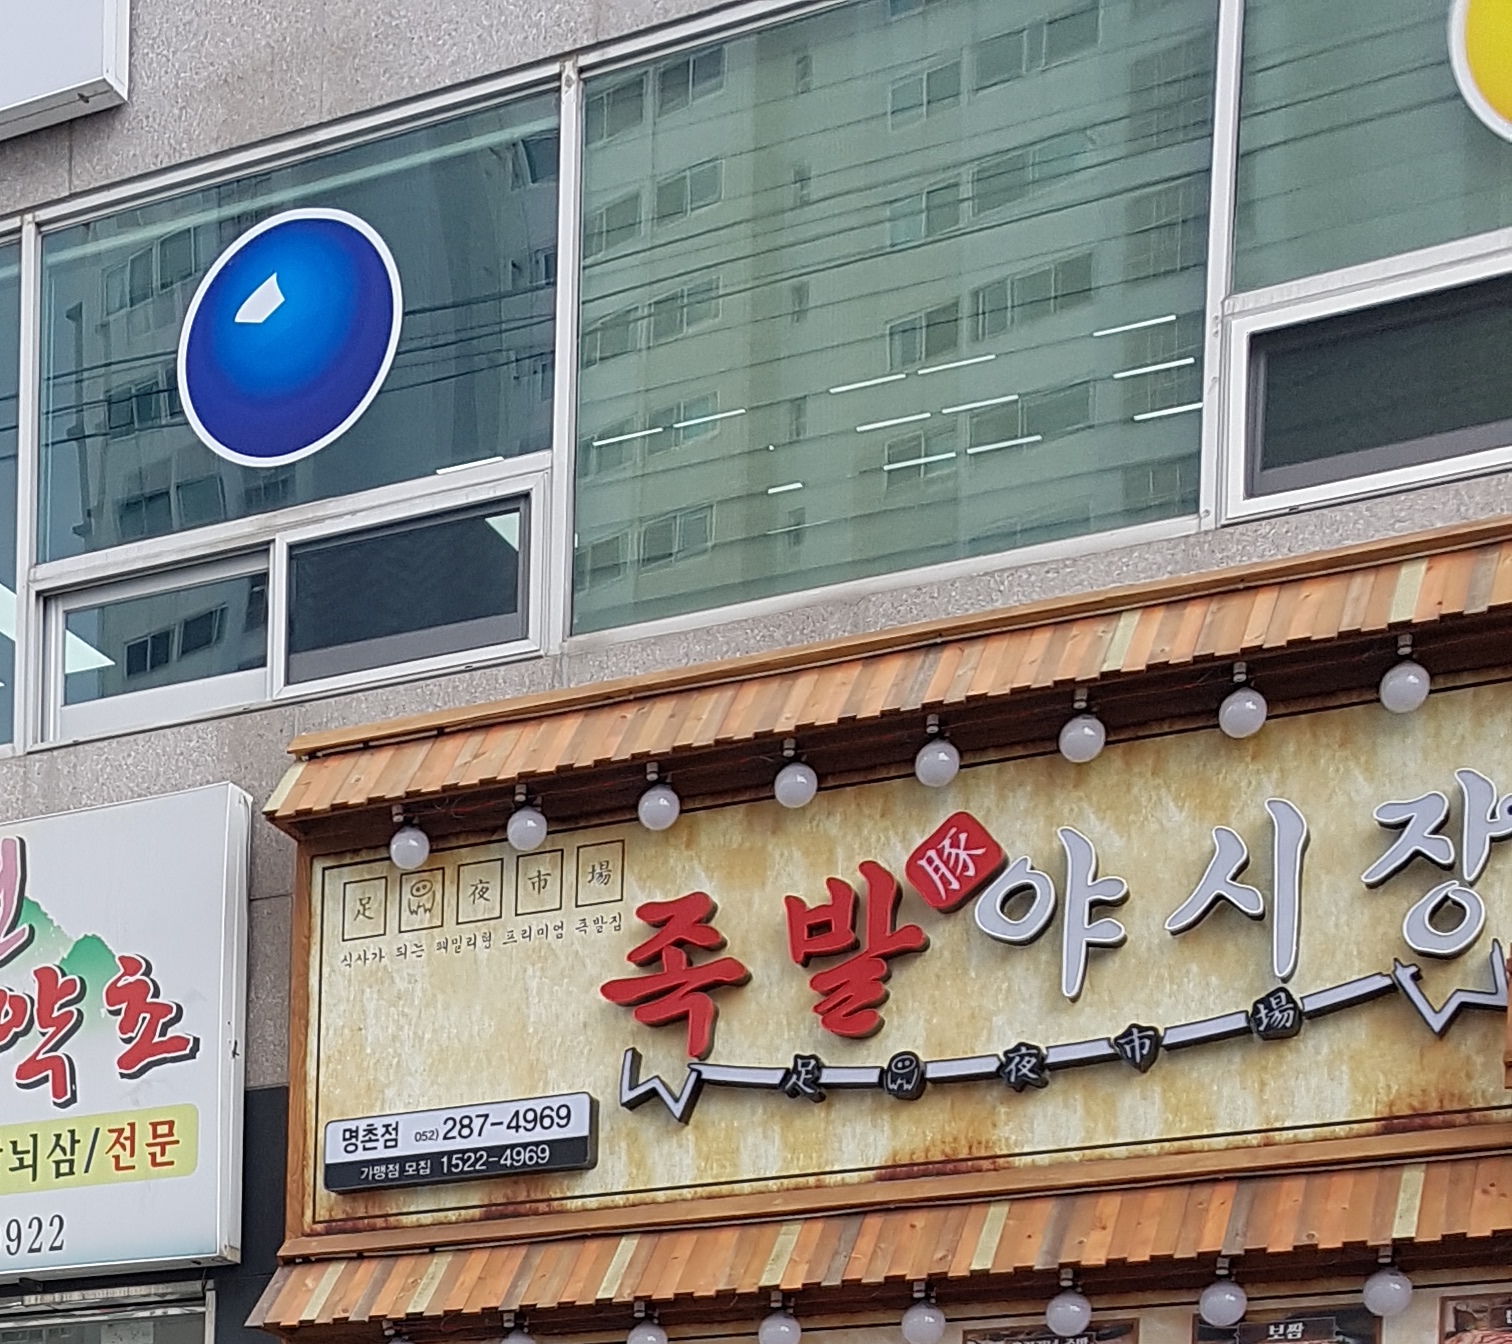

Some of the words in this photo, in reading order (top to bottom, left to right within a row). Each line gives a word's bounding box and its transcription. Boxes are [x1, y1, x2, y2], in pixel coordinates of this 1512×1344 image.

[974, 768, 1512, 1004] 야시장
[341, 947, 386, 968] 식사가
[395, 943, 426, 960] 되는
[502, 920, 565, 946] 프리미엄
[600, 860, 932, 1060] 족발
[341, 1121, 400, 1154] 명촌점
[442, 1104, 572, 1142] 287-4969
[360, 1164, 400, 1181] 가맹점
[403, 1159, 431, 1177] 모집
[440, 1144, 551, 1174] 1522-4969
[1267, 1322, 1305, 1340] 보쌈
